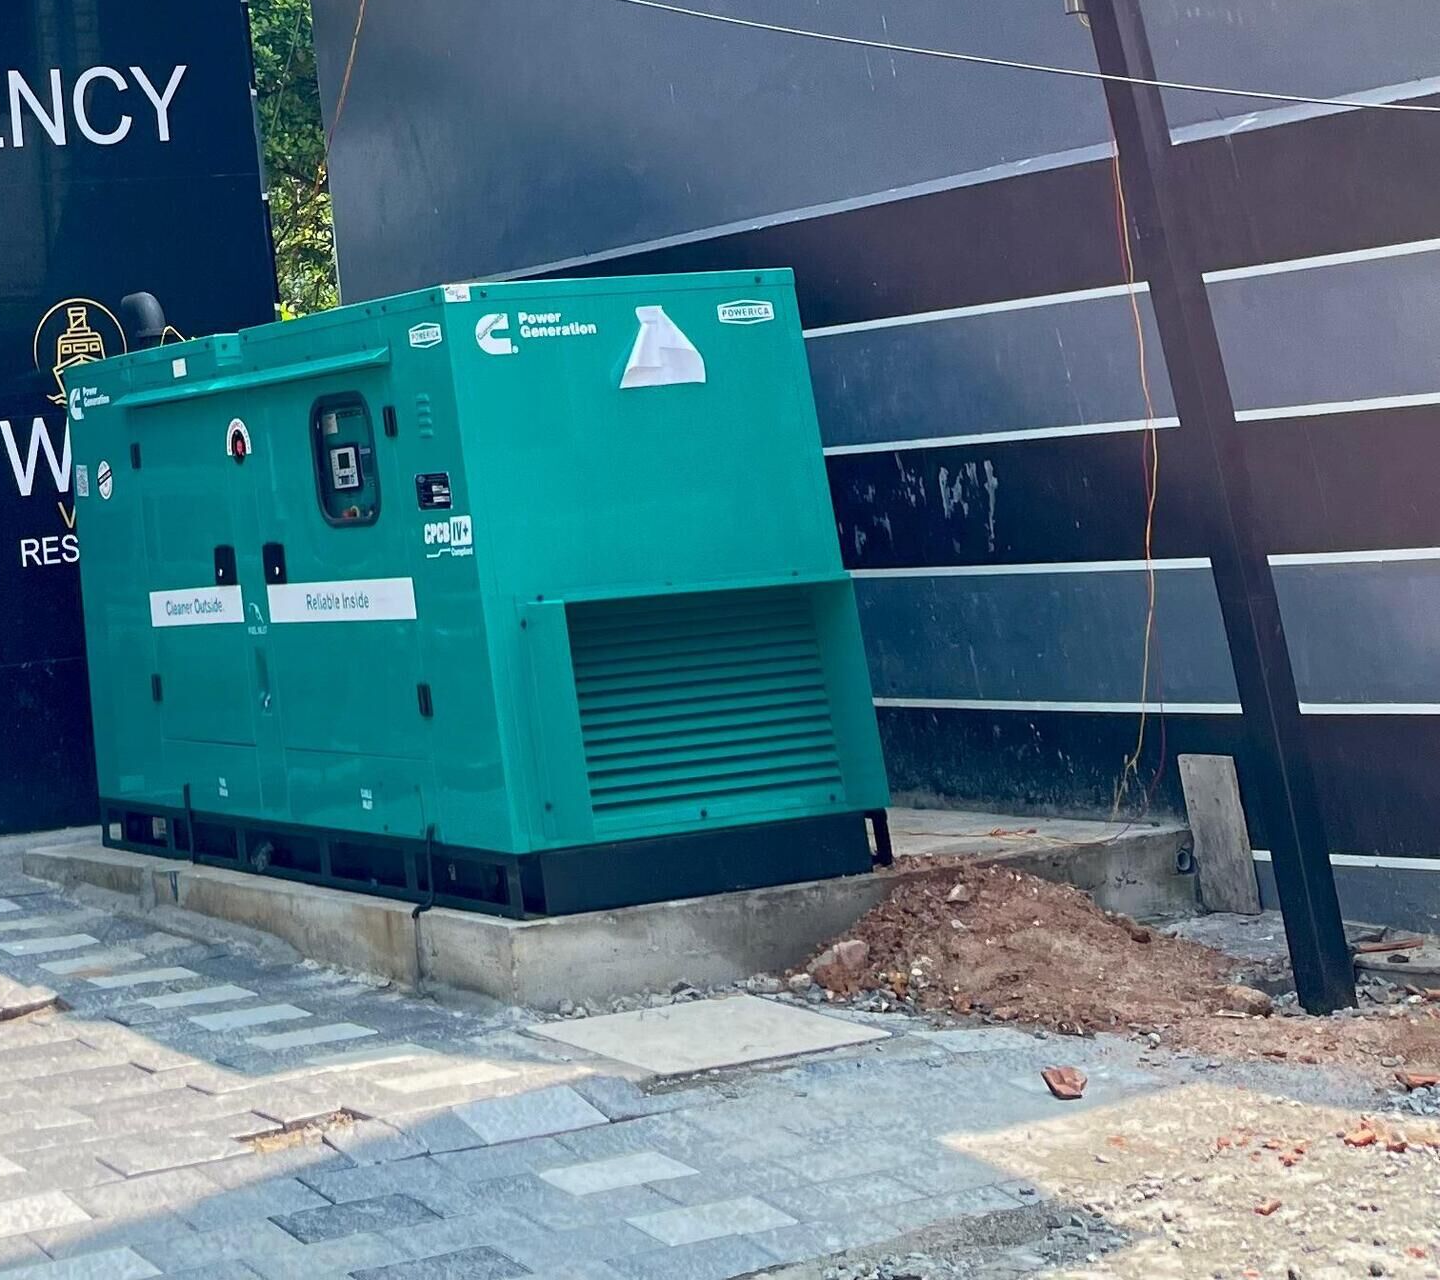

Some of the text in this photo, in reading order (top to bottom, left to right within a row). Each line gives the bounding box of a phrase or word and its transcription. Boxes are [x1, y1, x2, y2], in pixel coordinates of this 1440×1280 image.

[517, 312, 562, 326] Power
[720, 304, 771, 320] POWERICA
[520, 321, 597, 339] Generation
[166, 599, 193, 616] Cleaner
[306, 592, 369, 611] Reliable Inside
